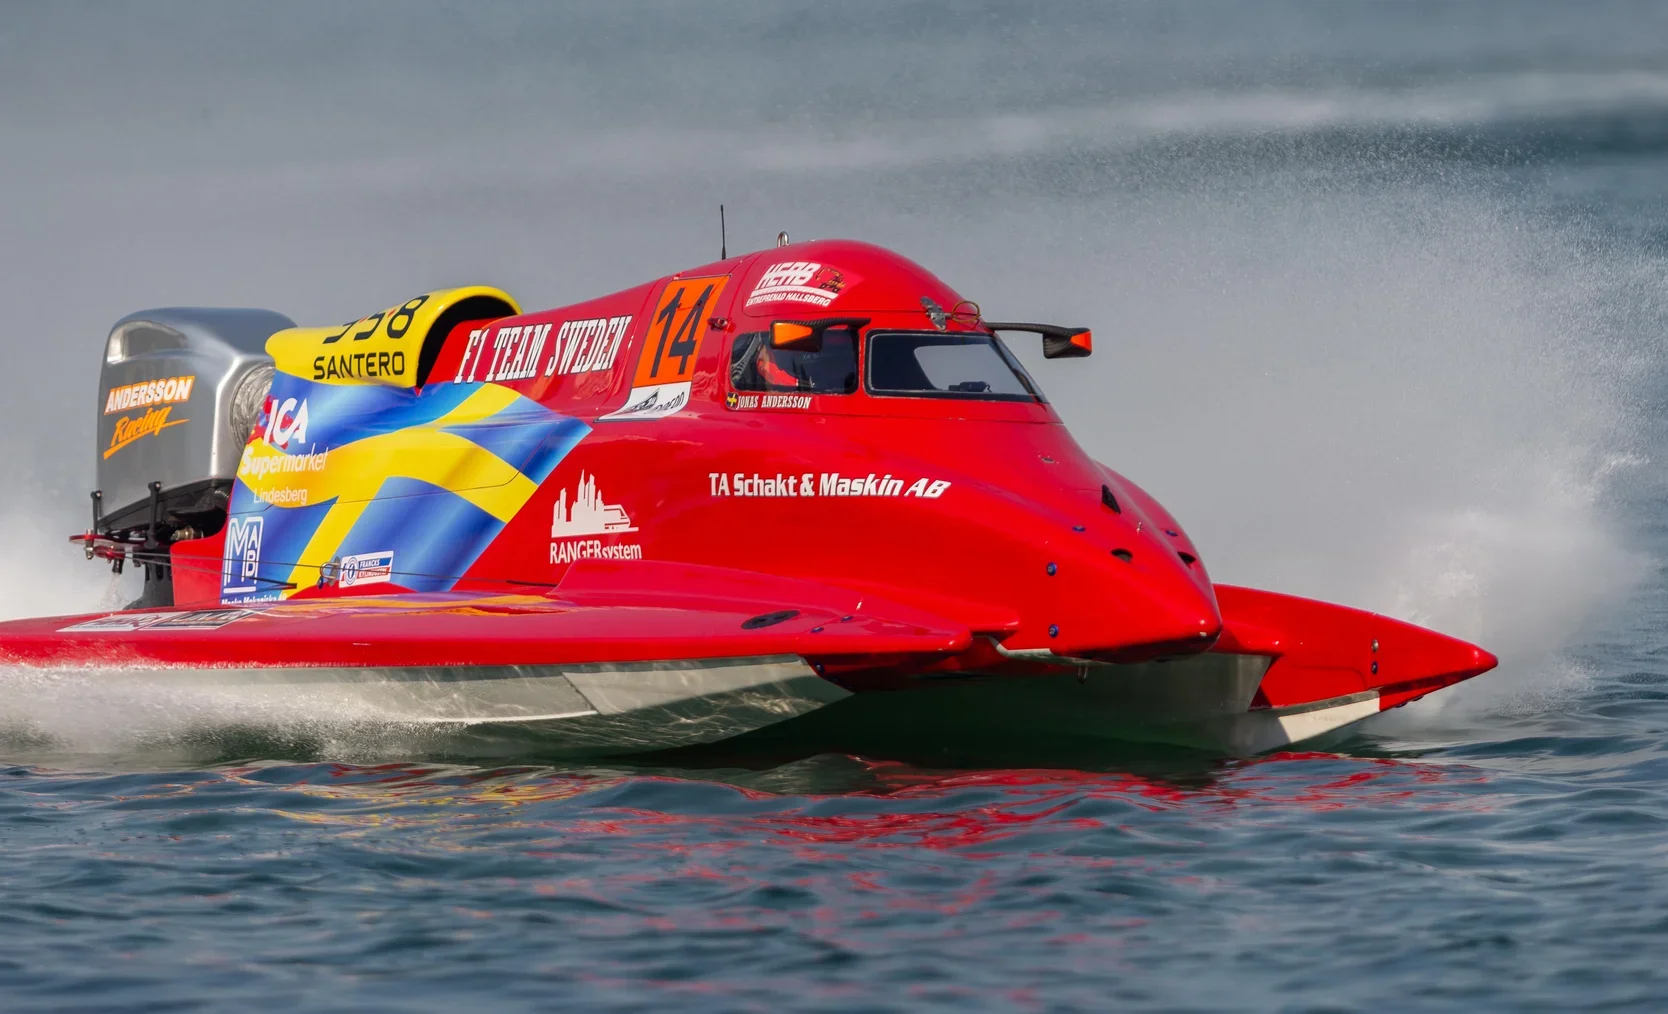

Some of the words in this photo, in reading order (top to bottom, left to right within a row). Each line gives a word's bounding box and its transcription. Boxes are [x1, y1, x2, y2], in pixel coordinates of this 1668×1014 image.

[754, 262, 821, 291] HEAB
[785, 293, 831, 307] HALLSBERG
[655, 284, 715, 379] 14
[313, 351, 405, 381] SANTERO
[453, 328, 490, 385] F1
[485, 324, 553, 383] TEAM
[544, 315, 633, 377] SWEDEN
[104, 377, 194, 415] ANDERSSON
[736, 395, 759, 410] JONAS
[761, 396, 812, 410] ANDERSSON
[108, 406, 174, 448] Racing
[263, 397, 309, 446] ICA
[240, 442, 329, 481] Supermarket
[253, 486, 308, 505] Lindesberg
[709, 472, 730, 497] TA
[733, 472, 797, 497] Schakt
[800, 472, 815, 497] &
[818, 472, 904, 498] Maskin
[903, 477, 952, 499] AB
